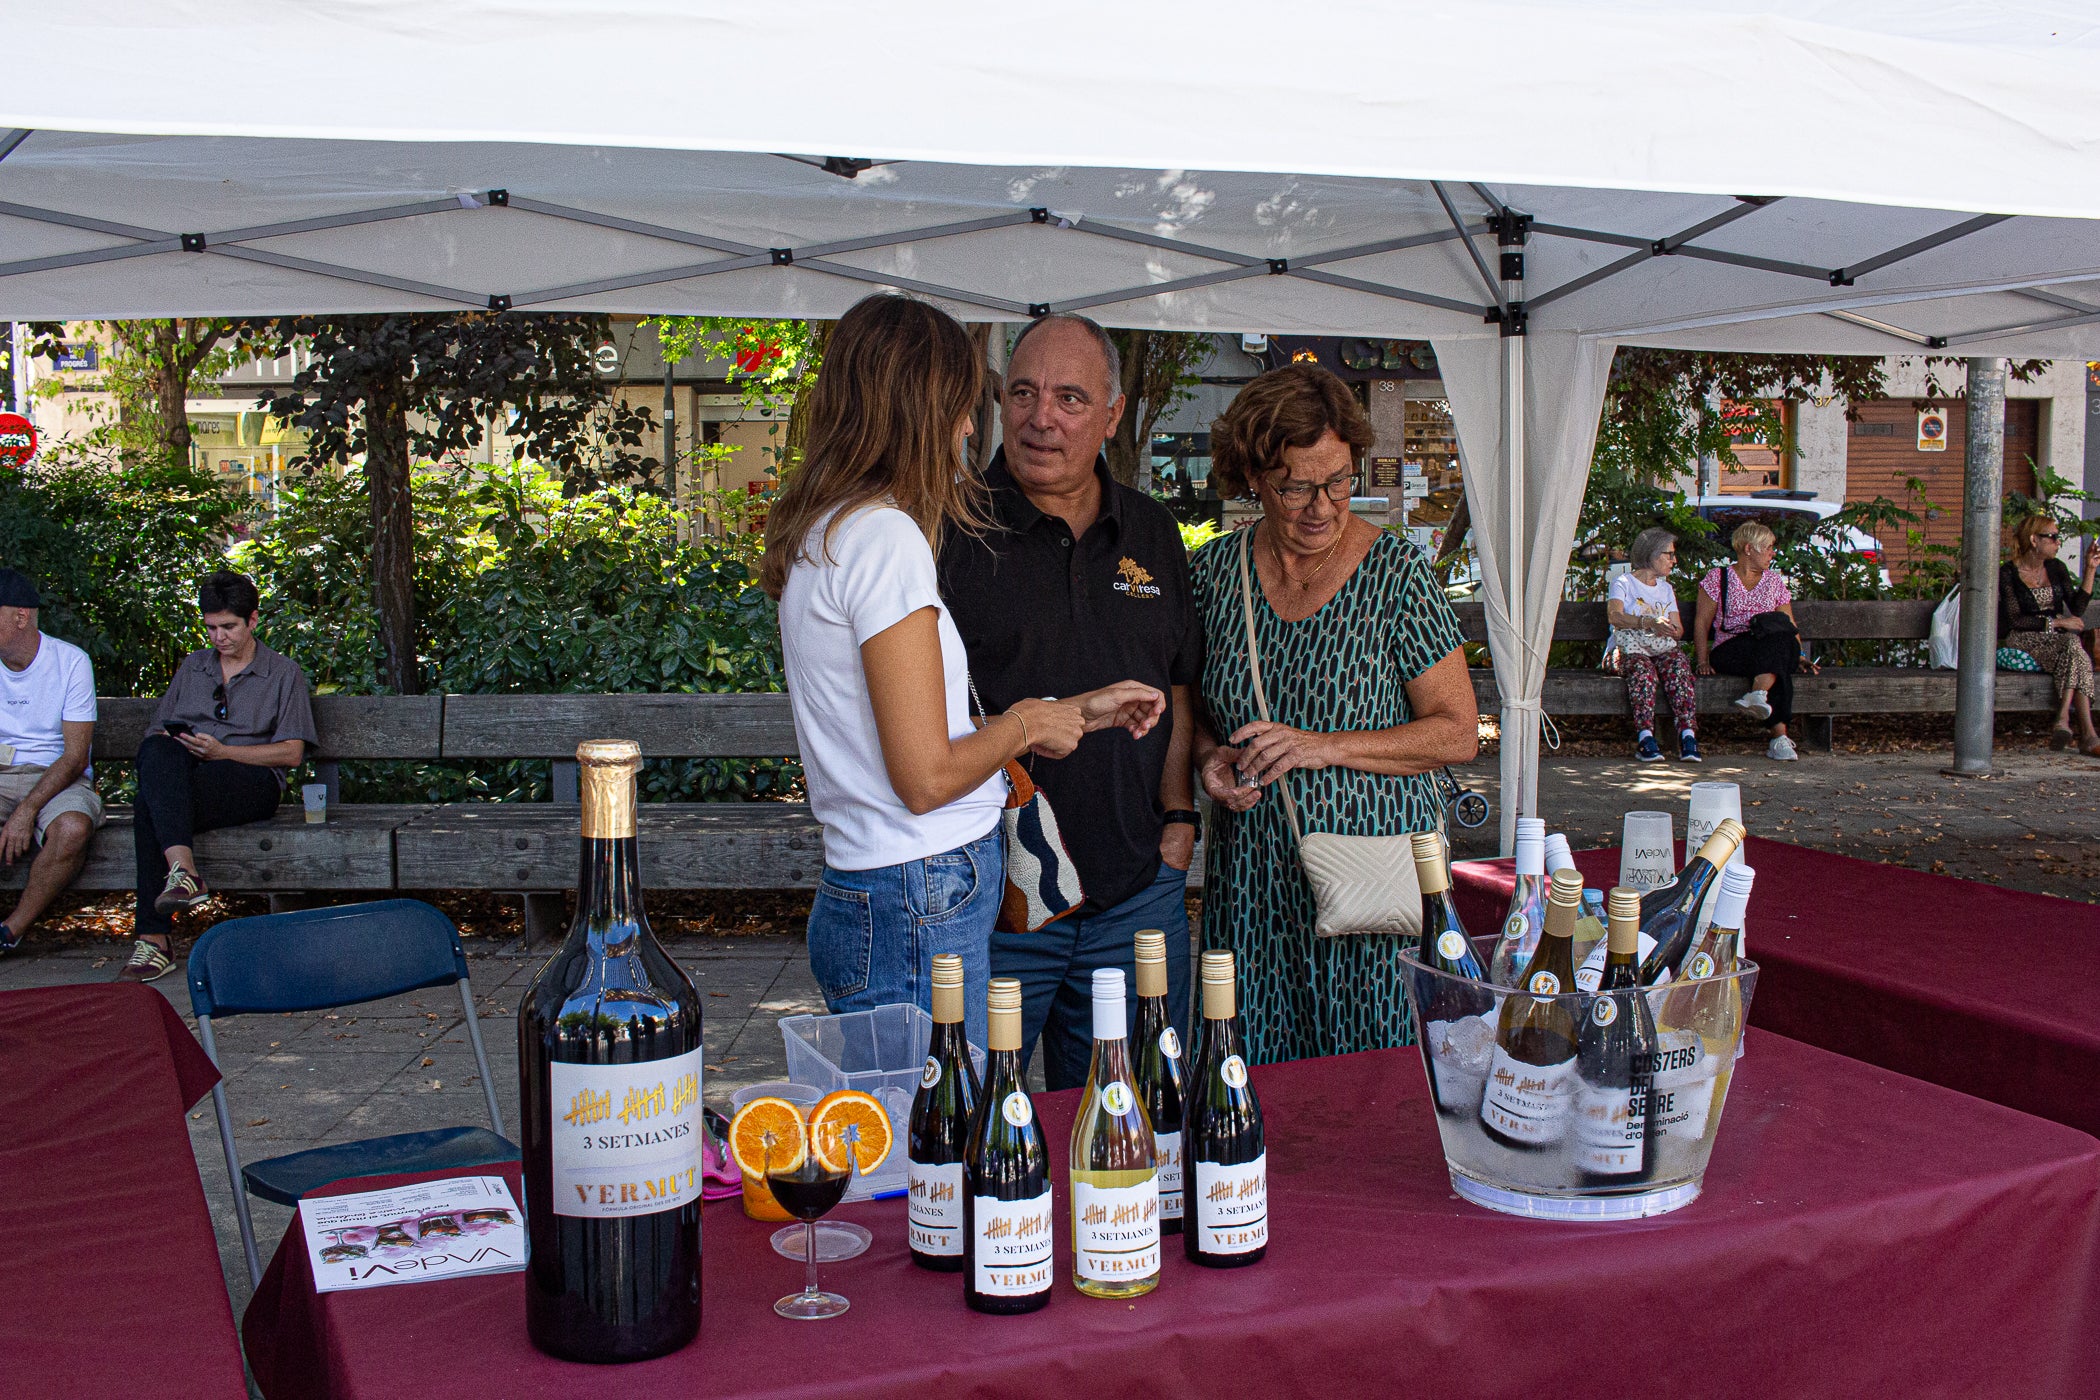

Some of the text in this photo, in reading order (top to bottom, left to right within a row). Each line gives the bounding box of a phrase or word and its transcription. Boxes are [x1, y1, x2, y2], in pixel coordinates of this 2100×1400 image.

[60, 360, 88, 368] PROGRÉS
[1378, 380, 1395, 392] 38
[1814, 395, 1832, 407] 37
[1626, 1111, 1690, 1130] Denminació
[583, 1121, 690, 1150] 3 SETMANES
[575, 1165, 697, 1204] VERMUT
[1217, 1207, 1223, 1215] 3
[1091, 1226, 1154, 1241] 3 SETMANES
[994, 1245, 1001, 1254] 3
[1088, 1252, 1157, 1272] VERMUT
